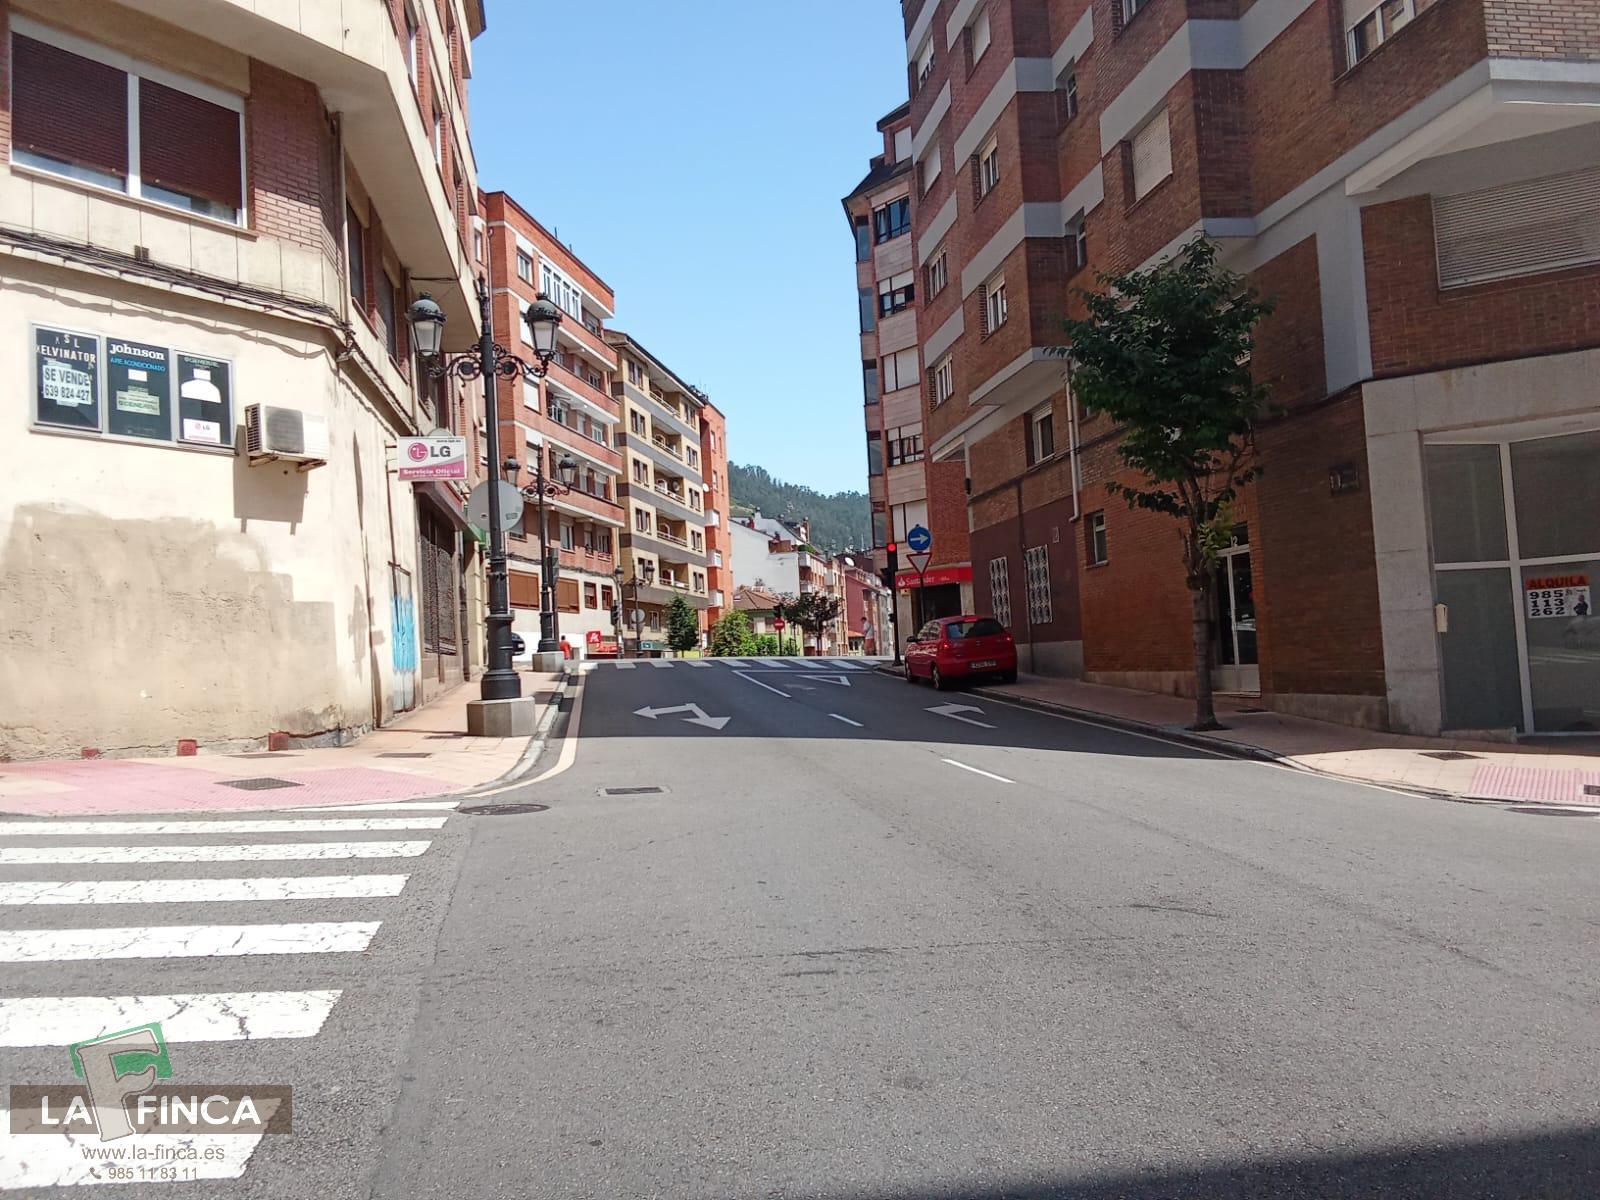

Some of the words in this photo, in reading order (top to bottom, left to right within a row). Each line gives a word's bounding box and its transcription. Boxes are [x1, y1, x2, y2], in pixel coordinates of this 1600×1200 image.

[110, 343, 165, 361] johnson
[44, 367, 57, 382] SE
[59, 369, 90, 387] VENDE
[44, 384, 59, 397] 639
[61, 386, 75, 399] 824
[430, 445, 451, 458] LG
[906, 574, 935, 586] Santnder
[1527, 575, 1588, 589] ALQUILA
[1530, 589, 1564, 600] 985
[1531, 598, 1565, 608] 113
[1531, 607, 1566, 616] 262
